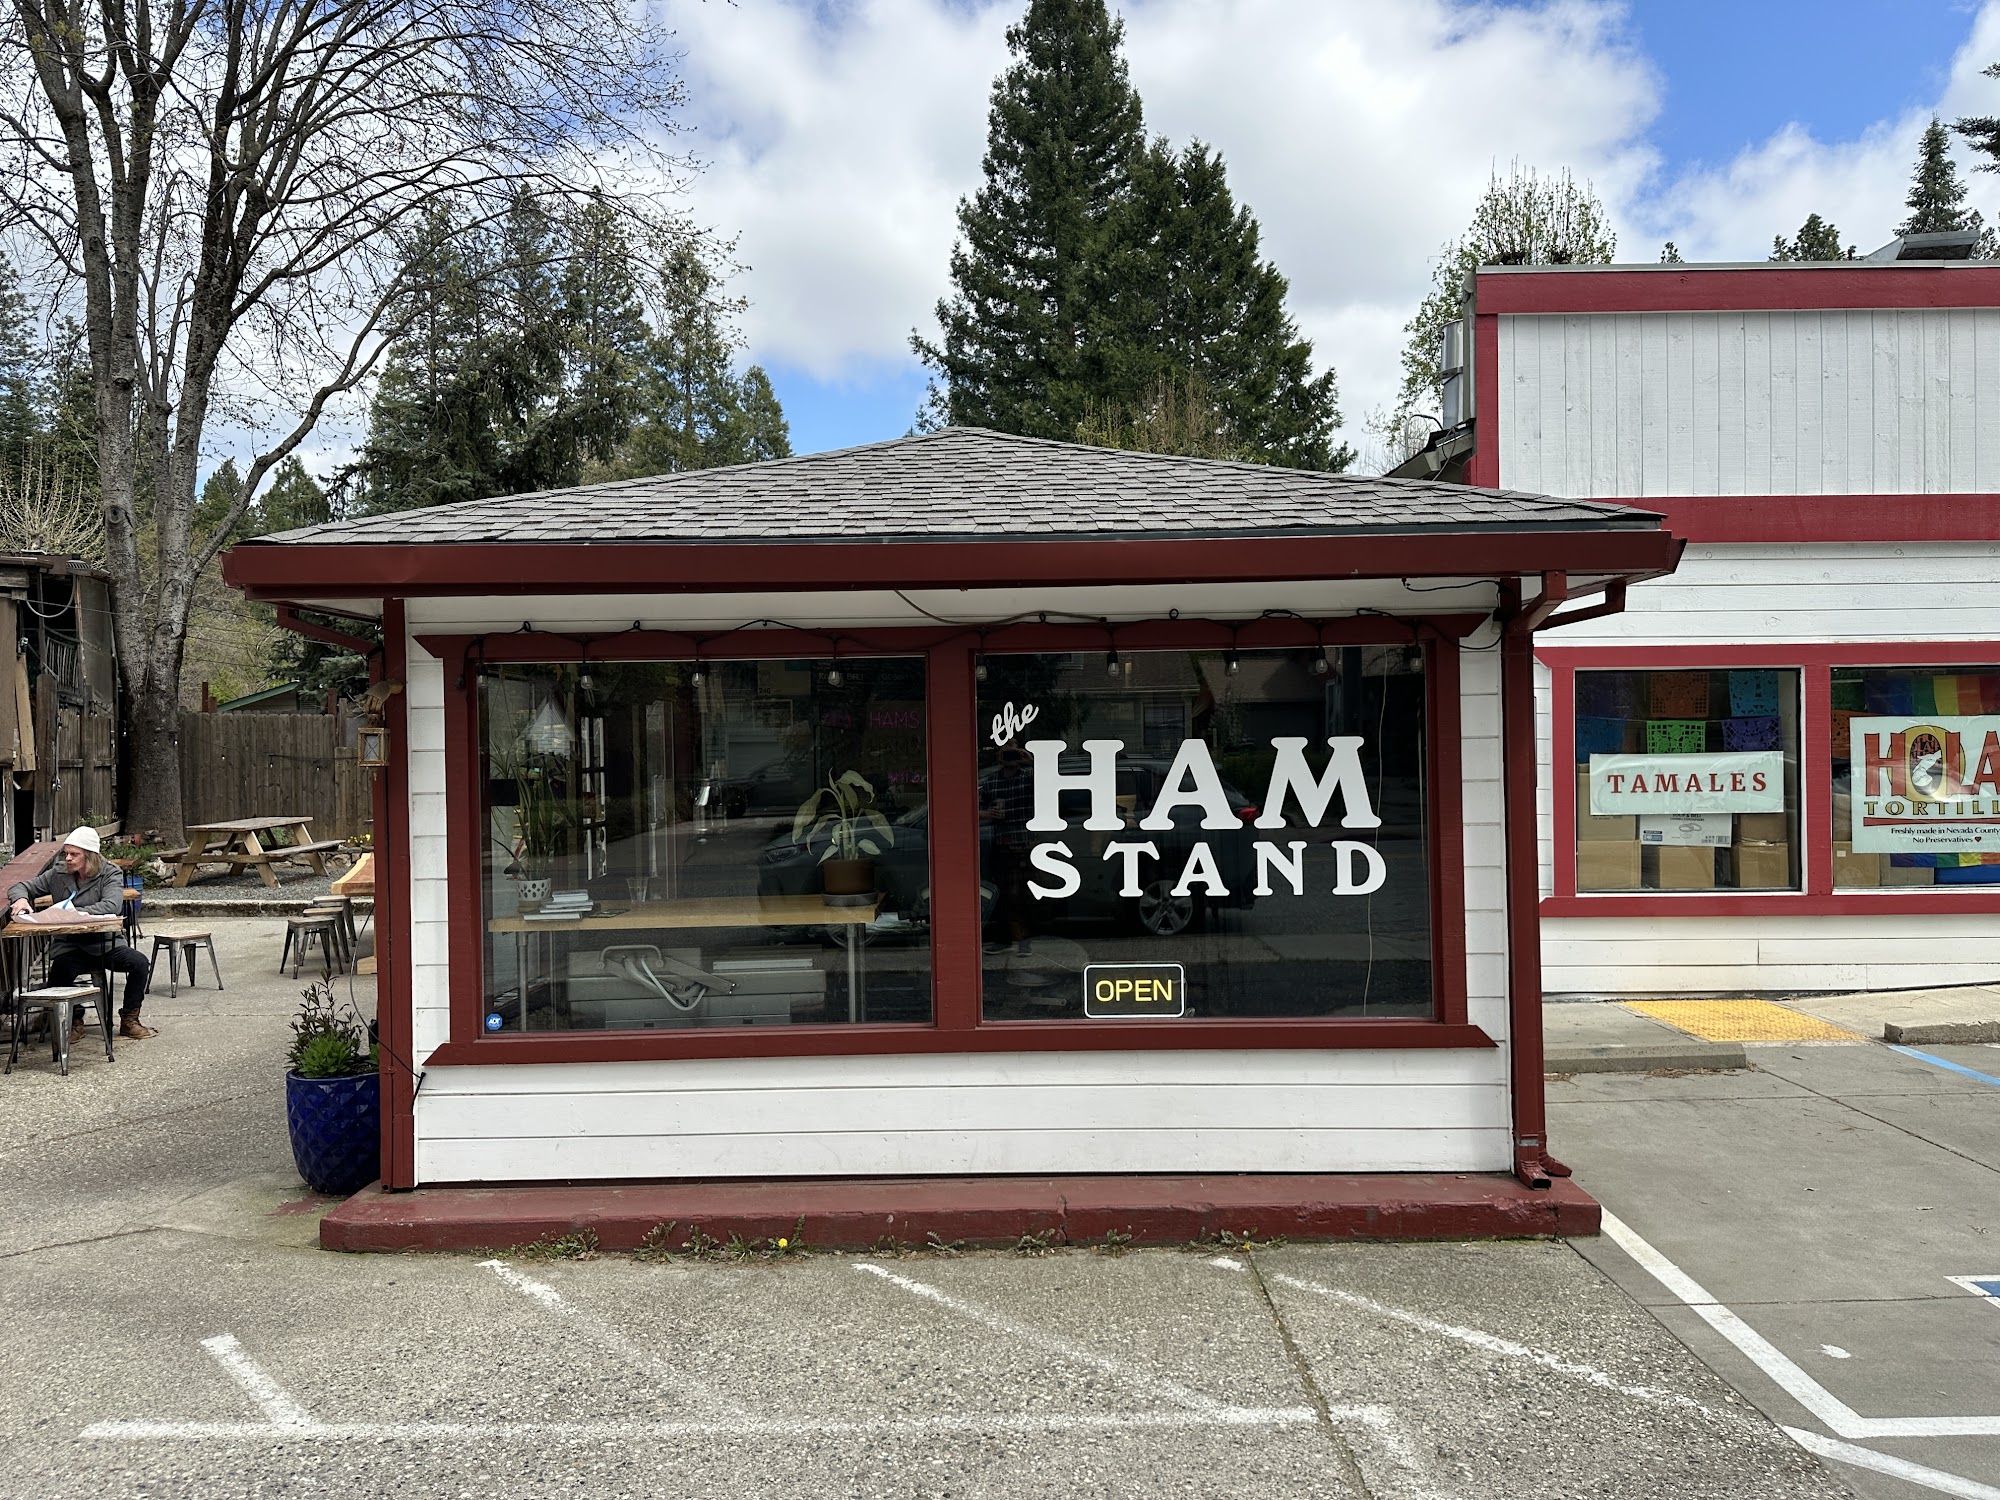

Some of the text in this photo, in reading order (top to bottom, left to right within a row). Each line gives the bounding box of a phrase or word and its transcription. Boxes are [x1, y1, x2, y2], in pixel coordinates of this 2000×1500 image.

[870, 710, 920, 729] HAMS
[990, 701, 1039, 747] the
[1025, 736, 1382, 832] HAM
[1607, 772, 1767, 793] TAMALES
[1891, 827, 1915, 836] Freshly
[1027, 840, 1387, 900] STAND
[1094, 978, 1173, 1002] OPEN
